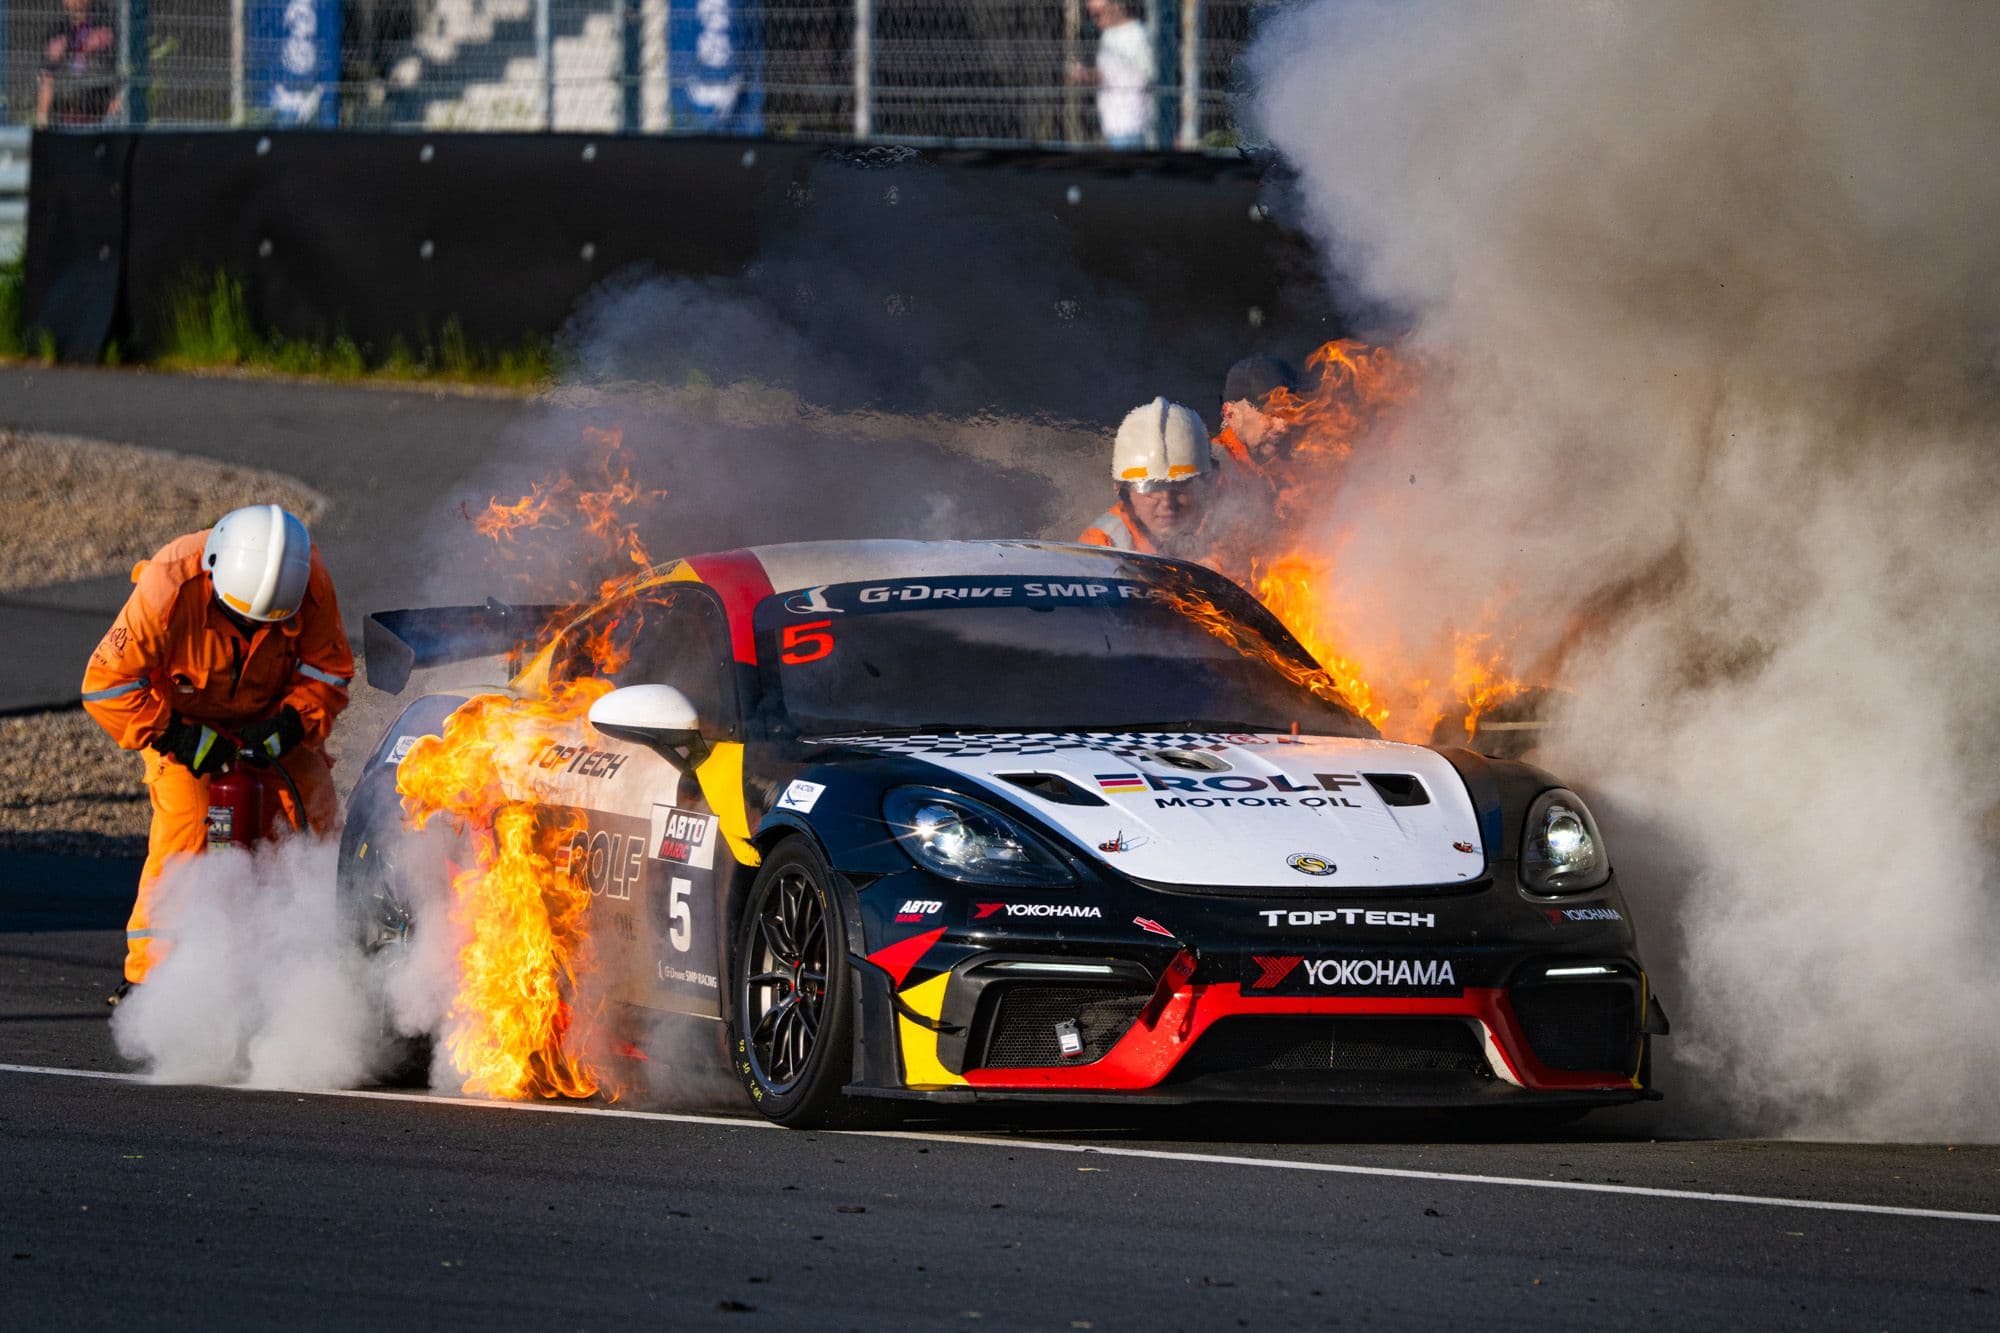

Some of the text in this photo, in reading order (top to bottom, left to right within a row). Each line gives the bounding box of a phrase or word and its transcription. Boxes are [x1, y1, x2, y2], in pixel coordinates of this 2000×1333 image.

[1023, 583, 1109, 598] SMP
[781, 619, 835, 665] 5
[1141, 773, 1362, 793] ROLF
[1154, 797, 1362, 809] MOTOR OIL
[665, 814, 706, 844] АВТО
[569, 829, 646, 901] ROLF
[669, 876, 692, 953] 5
[898, 900, 943, 914] АВТО
[1005, 904, 1102, 919] YOKOHAMA
[1562, 907, 1624, 921] YOKOHAMA
[1259, 908, 1436, 928] TOPTECH
[1303, 960, 1456, 985] YOKOHAMA
